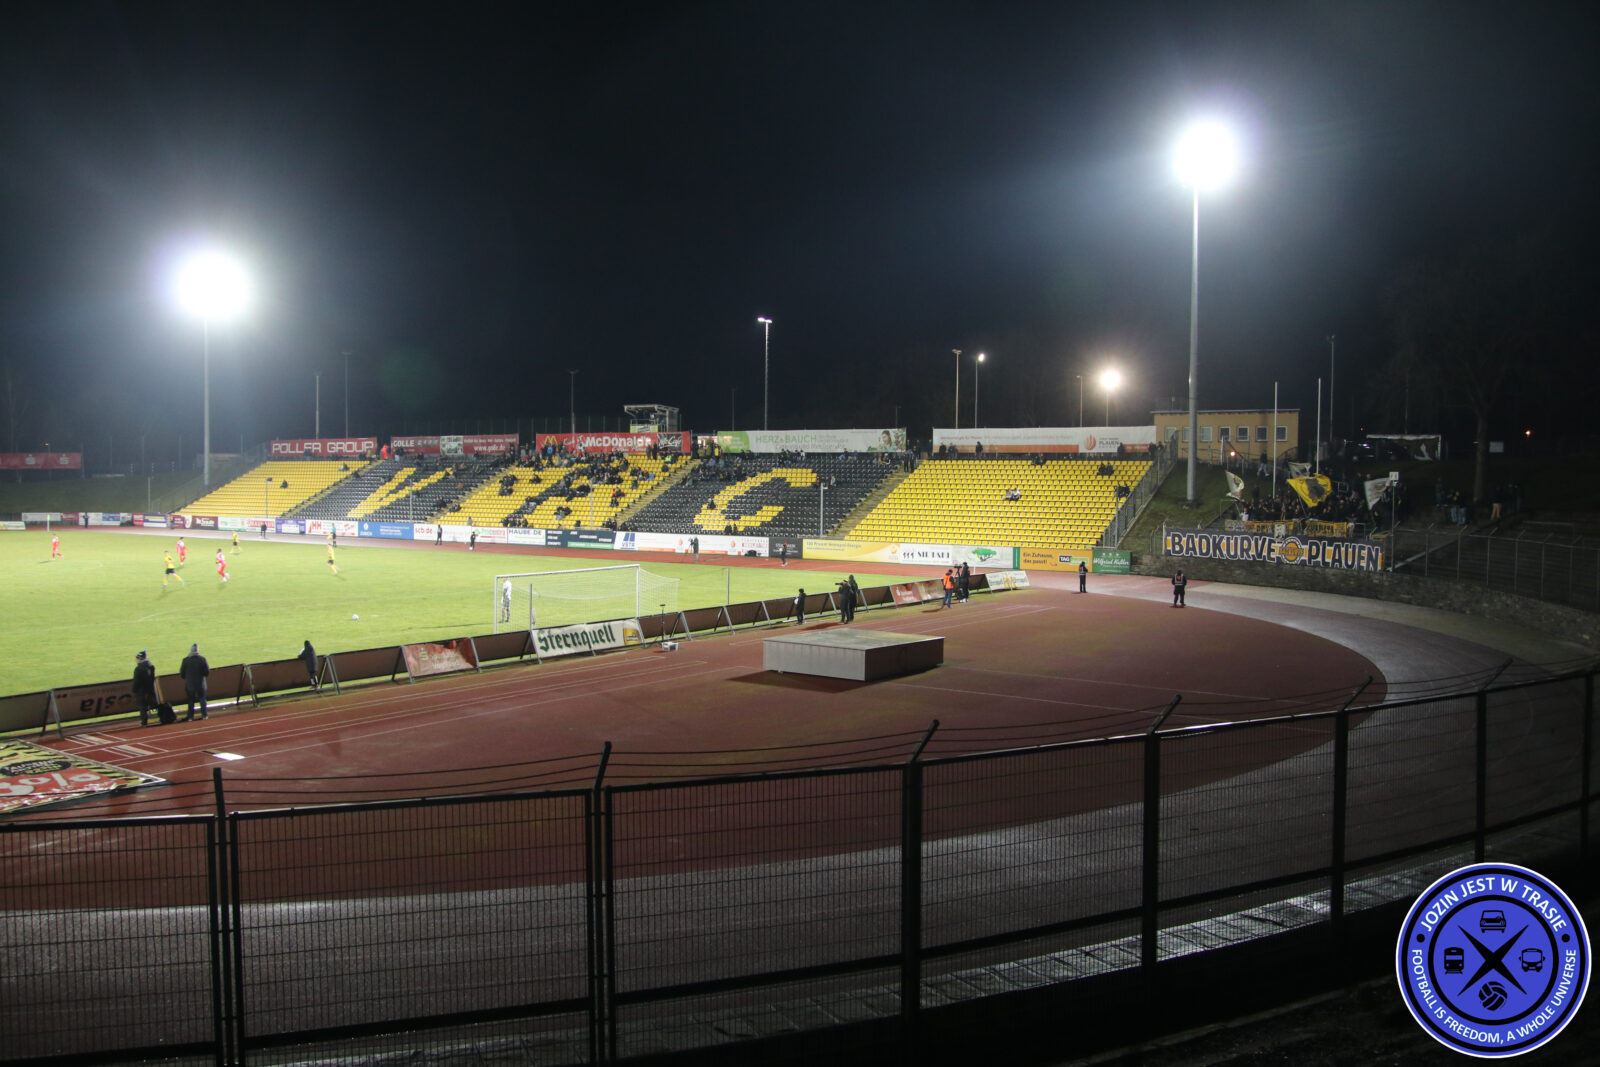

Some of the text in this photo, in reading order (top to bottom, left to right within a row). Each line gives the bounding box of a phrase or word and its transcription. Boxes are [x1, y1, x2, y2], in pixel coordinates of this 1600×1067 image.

[327, 441, 374, 453] GROUP
[585, 435, 652, 448] McDonald's
[1170, 531, 1381, 571] BADKURVE PLAUEN
[537, 623, 616, 652] Sternquell
